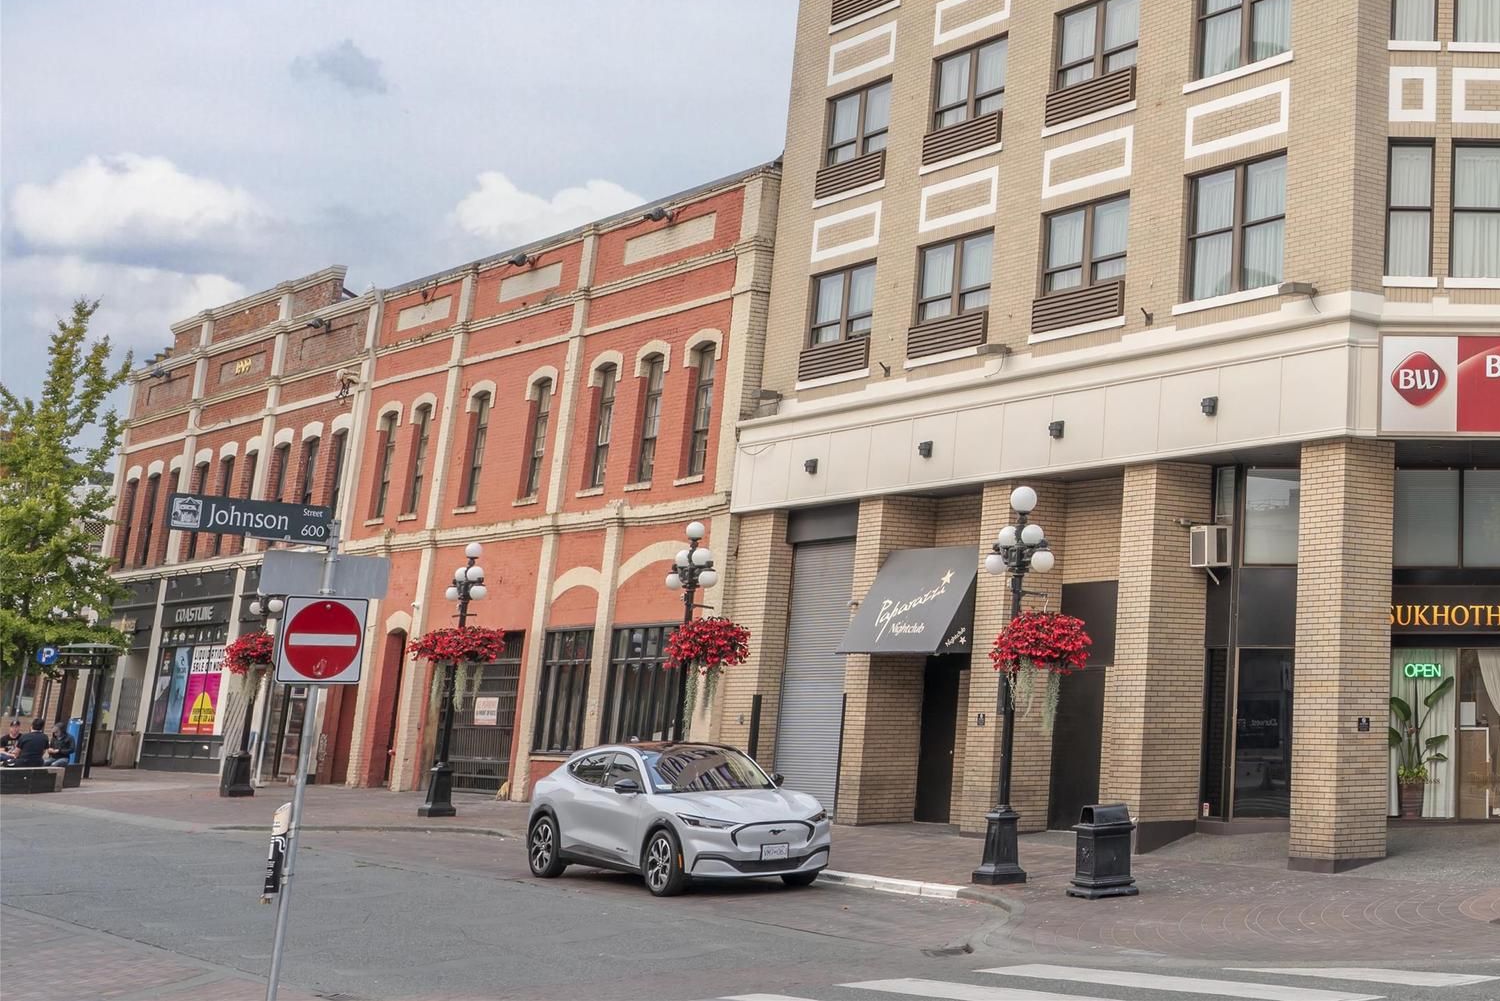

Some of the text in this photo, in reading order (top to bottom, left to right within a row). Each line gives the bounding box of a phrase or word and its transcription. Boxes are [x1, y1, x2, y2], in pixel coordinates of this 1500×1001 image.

[1399, 369, 1439, 389] BW
[206, 503, 289, 530] Johnson
[303, 508, 323, 517] Street
[301, 525, 325, 537] 600
[875, 585, 946, 643] Paparazzi
[889, 621, 925, 636] Nightclub
[945, 627, 966, 647] Nightclub
[1404, 663, 1441, 677] OPEN
